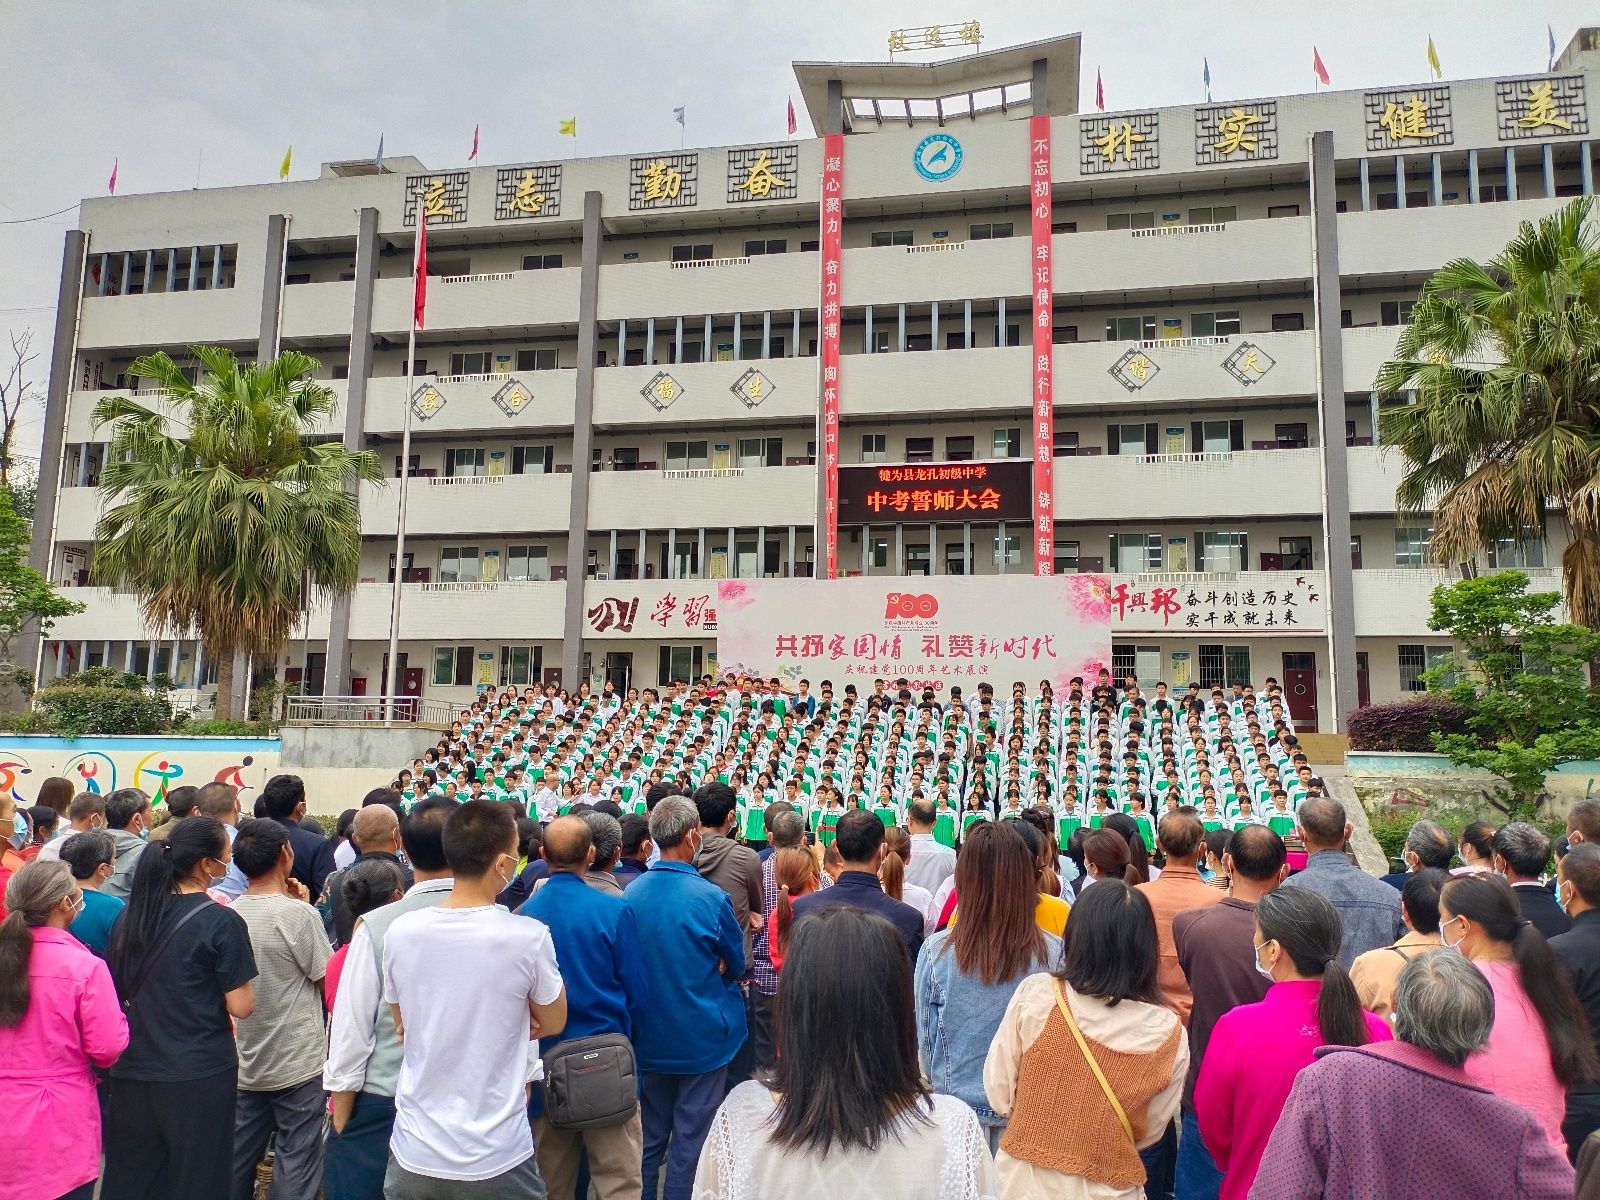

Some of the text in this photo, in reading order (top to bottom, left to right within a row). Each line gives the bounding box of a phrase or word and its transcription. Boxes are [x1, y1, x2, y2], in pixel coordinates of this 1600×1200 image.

[879, 466, 987, 482] 犍为县龙孔初级中学
[867, 488, 1001, 512] 中考誓师大会
[1184, 589, 1299, 607] 奋斗创造历史
[1185, 609, 1299, 628] 实干成就未来
[775, 633, 1057, 661] 共抒家国情 礼赞新时代
